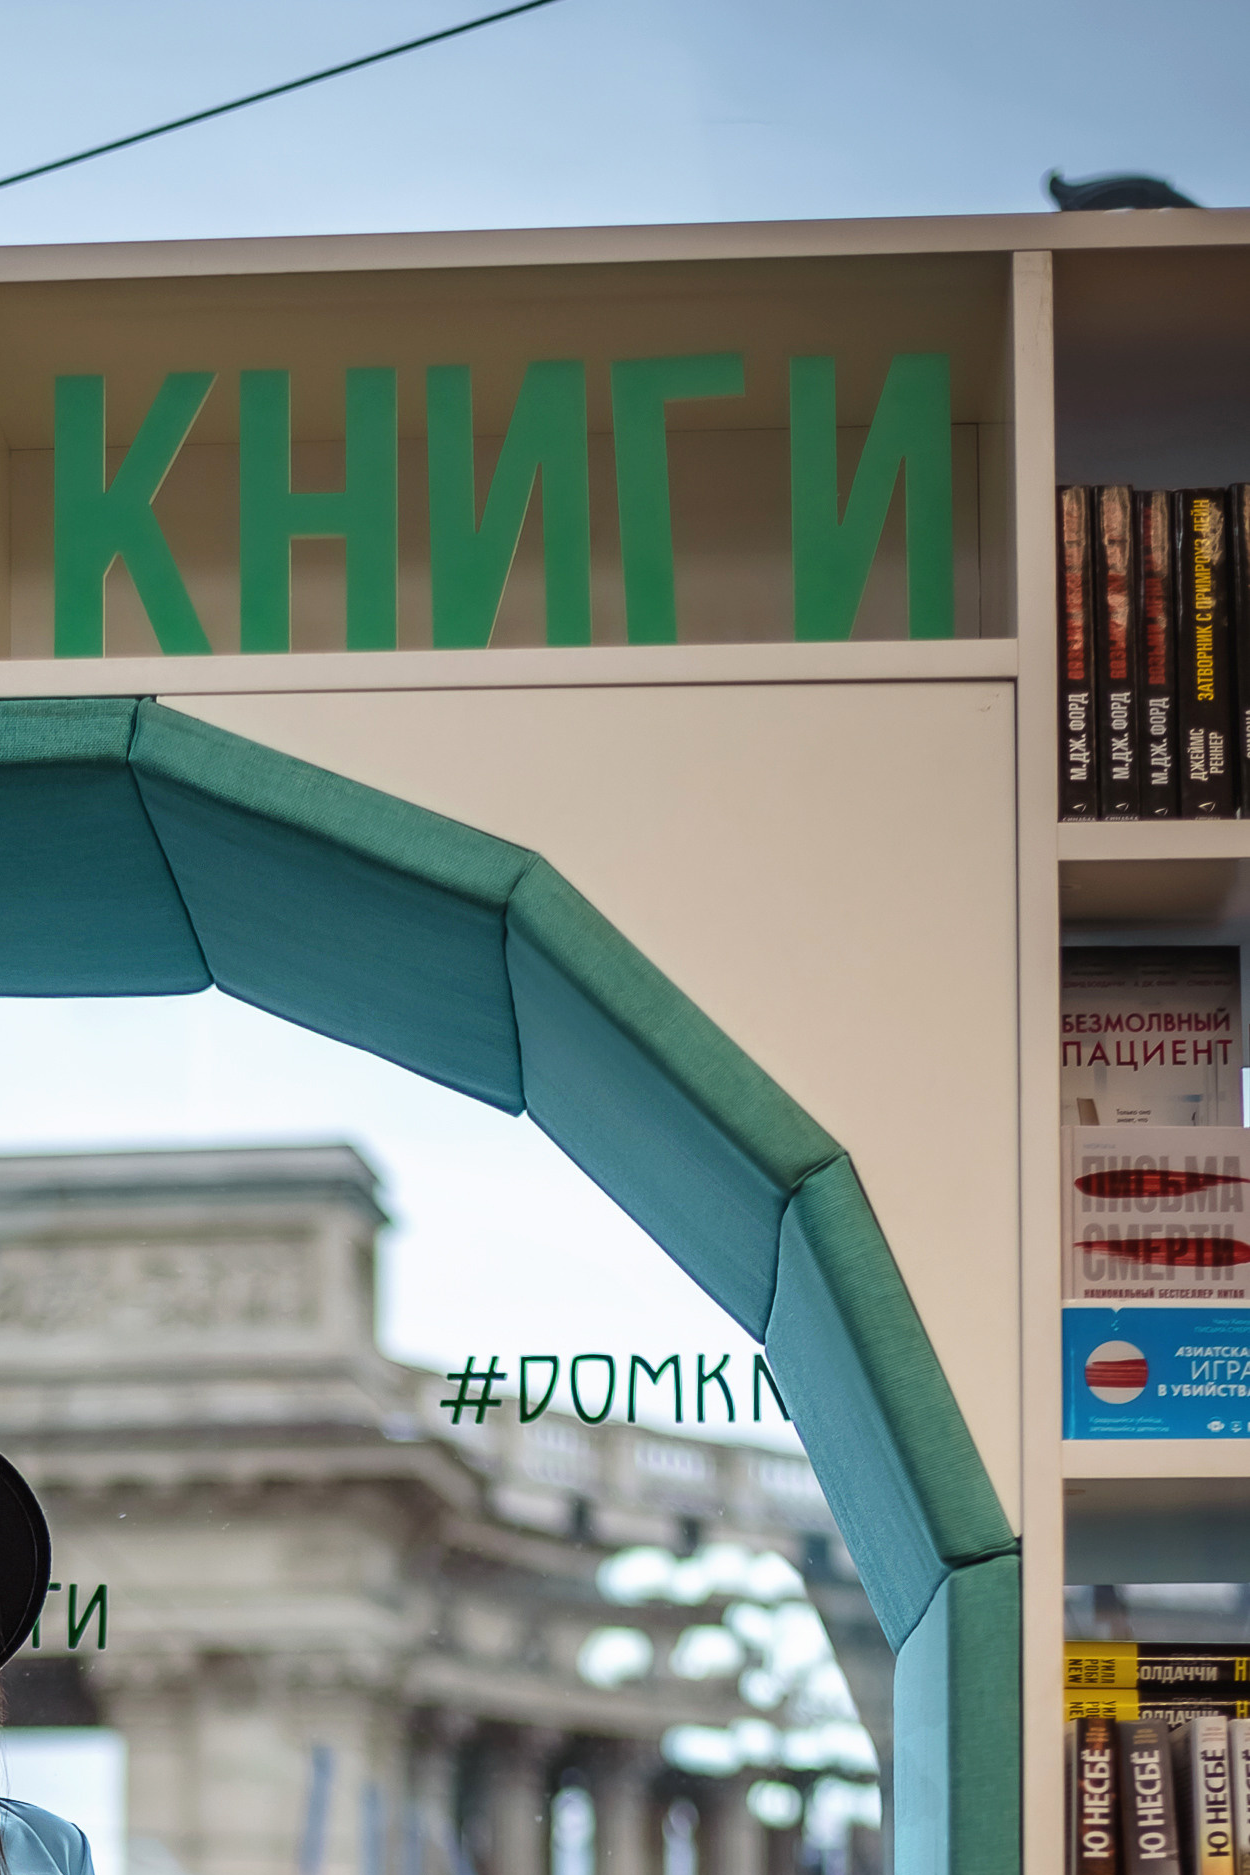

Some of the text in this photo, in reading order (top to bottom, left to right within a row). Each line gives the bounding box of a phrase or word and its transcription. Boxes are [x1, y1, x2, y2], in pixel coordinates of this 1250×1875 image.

[54, 352, 955, 658] КНИГИ
[1196, 613, 1212, 621] С
[1196, 625, 1215, 701] ЗАТВОРНИК
[1068, 693, 1089, 780] М.ДЖ. ФОРД
[1110, 692, 1131, 779] М.ДЖ. ФОРД
[1148, 697, 1170, 785] М.ДЖ. ФОРД
[1187, 728, 1208, 781] ДЖЕЙМС
[1209, 732, 1224, 774] РЕННЕР
[1062, 1008, 1230, 1033] БЕЗМОЛВНЫЙ
[1062, 1040, 1233, 1071] ПАЦИЕНТ
[1081, 1155, 1244, 1213] ПИСЬМА
[1082, 1222, 1234, 1282] СМЕРТИ
[1084, 1288, 1154, 1298] НАЦИОНАЛЬНЫЙ
[1159, 1289, 1213, 1298] БЕСТСЕЛЛЕР
[1174, 1346, 1250, 1358] АЗИАТСКА
[1158, 1384, 1168, 1397] В
[1068, 1659, 1083, 1683] NEW
[1082, 1749, 1111, 1858] Ю НЕСБЁ
[1131, 1749, 1167, 1860] Ю НЕСБЁ
[1200, 1748, 1229, 1857] Ю НЕСБЁ
